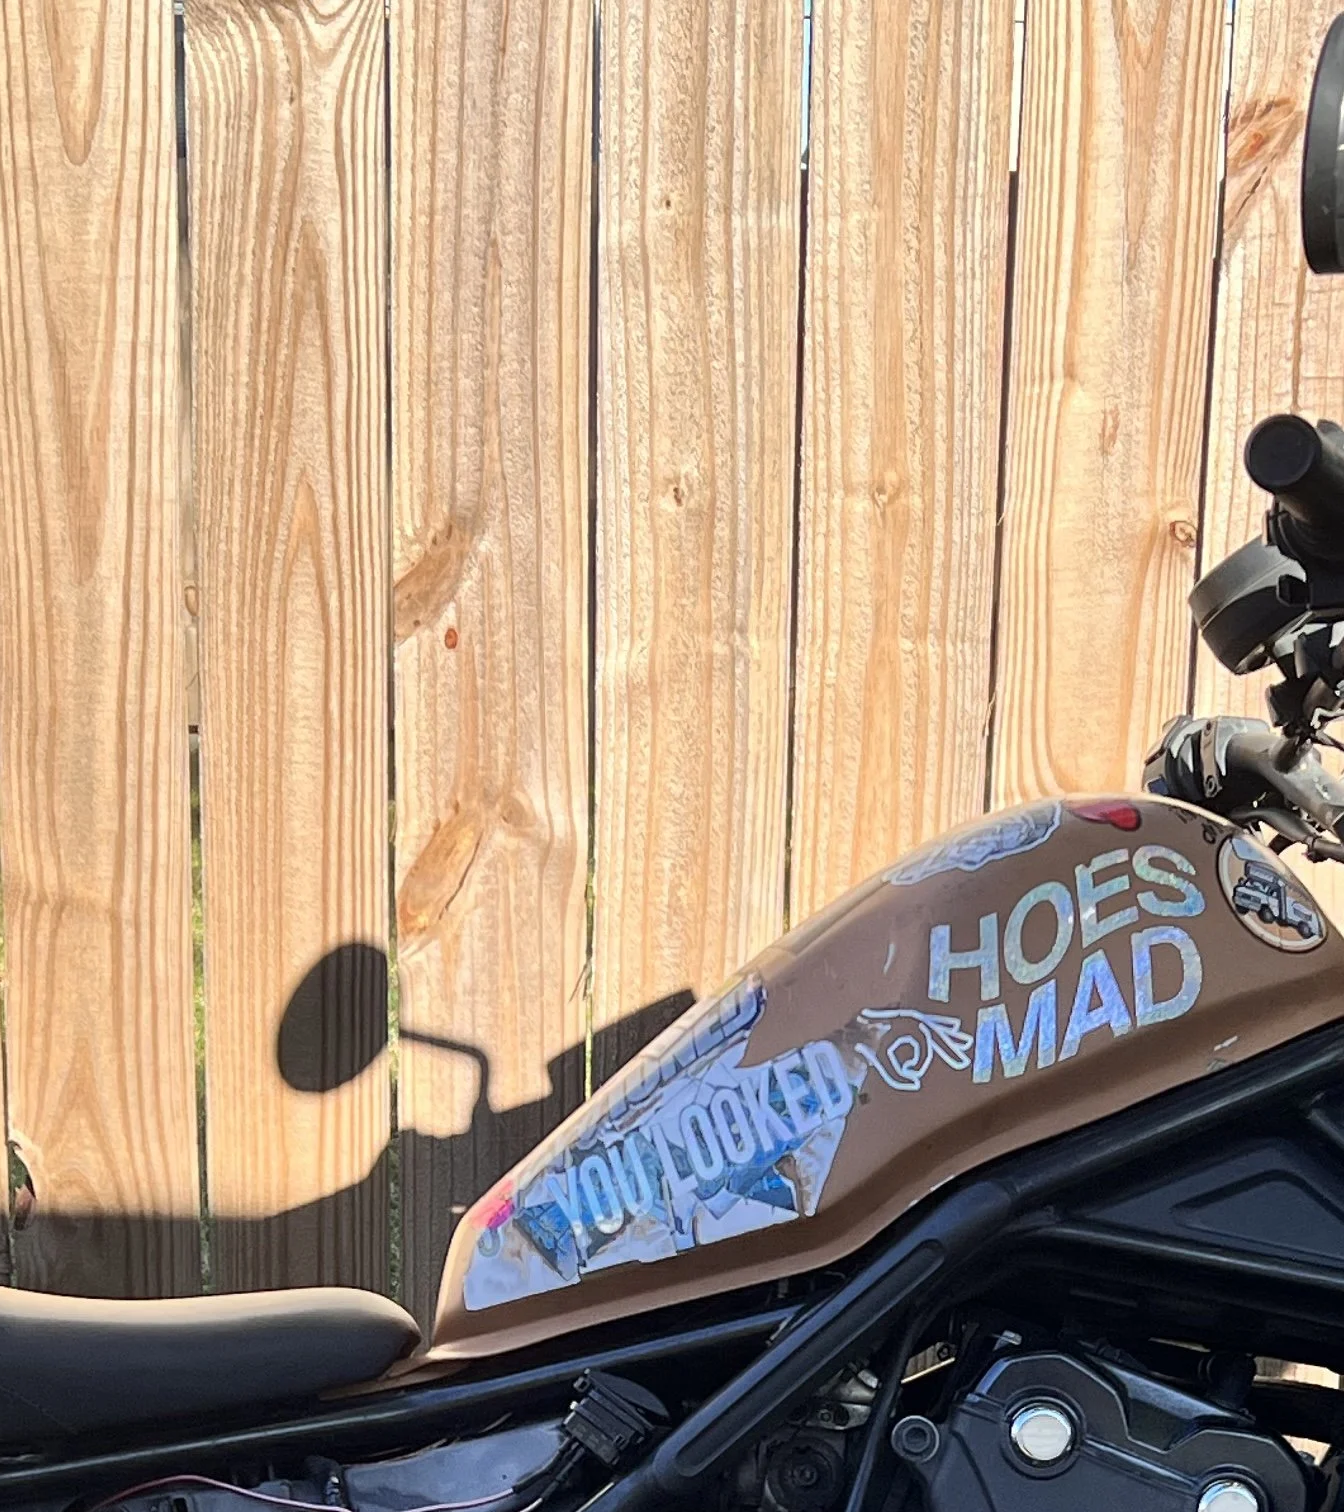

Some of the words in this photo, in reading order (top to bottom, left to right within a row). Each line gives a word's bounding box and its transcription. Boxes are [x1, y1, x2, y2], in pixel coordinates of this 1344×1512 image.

[928, 845, 1206, 1003] HOES
[972, 926, 1203, 1084] MAD
[545, 1132, 659, 1236] YOU
[653, 1040, 854, 1197] LOOKED
